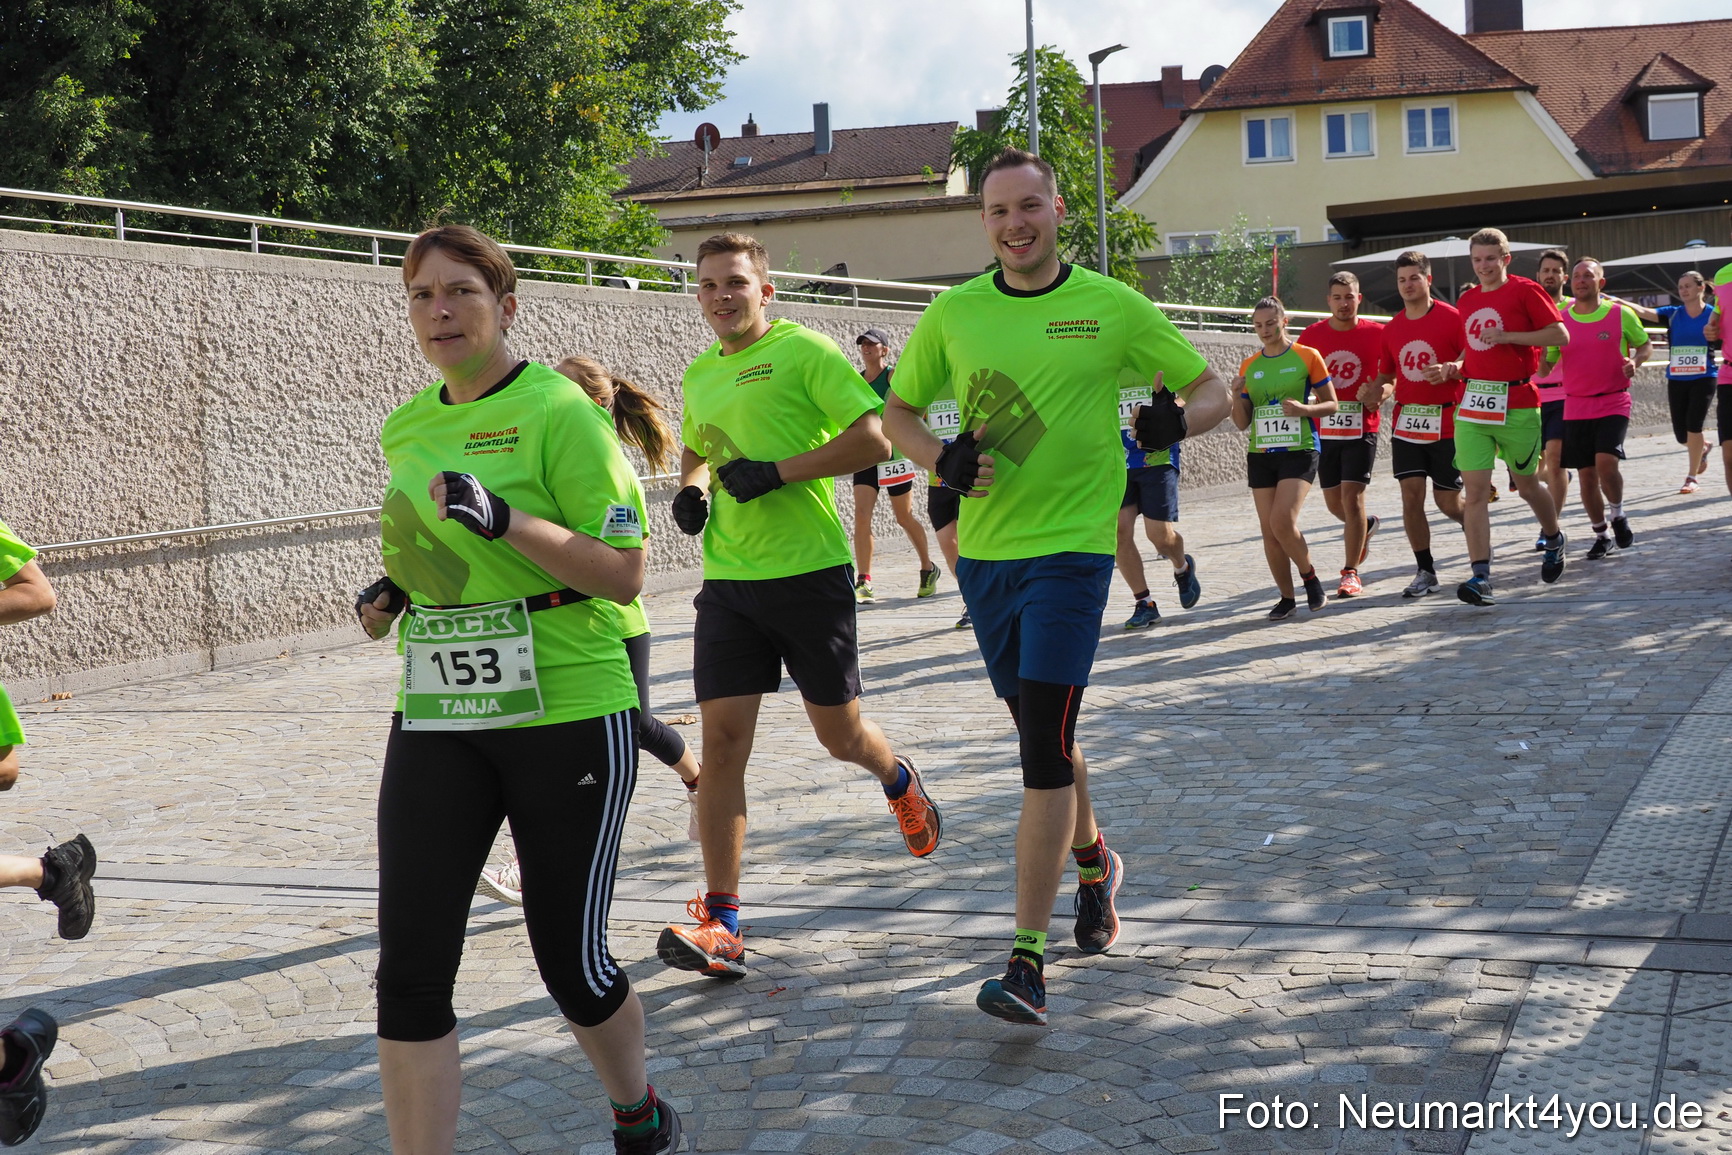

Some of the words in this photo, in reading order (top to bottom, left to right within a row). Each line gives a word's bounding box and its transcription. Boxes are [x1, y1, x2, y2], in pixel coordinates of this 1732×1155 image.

[1048, 319, 1098, 327] NEUMARKTER
[1045, 326, 1100, 334] ELEMENTELAUF
[1403, 350, 1431, 371] 48
[1678, 355, 1699, 365] 508
[1327, 359, 1356, 380] 48
[1120, 389, 1149, 399] OCK
[1468, 381, 1504, 394] BOCK
[930, 401, 959, 413] BOC
[1118, 401, 1143, 416] 11
[1469, 395, 1497, 410] 546
[1258, 407, 1285, 418] BOC
[1403, 405, 1438, 416] BOCK
[937, 412, 960, 426] 115
[1328, 414, 1353, 427] 545
[1405, 417, 1431, 430] 544
[1264, 420, 1290, 433] 114
[885, 463, 906, 477] 543
[410, 607, 518, 639] BOCK
[430, 647, 502, 686] 153
[439, 698, 502, 715] TANJA
